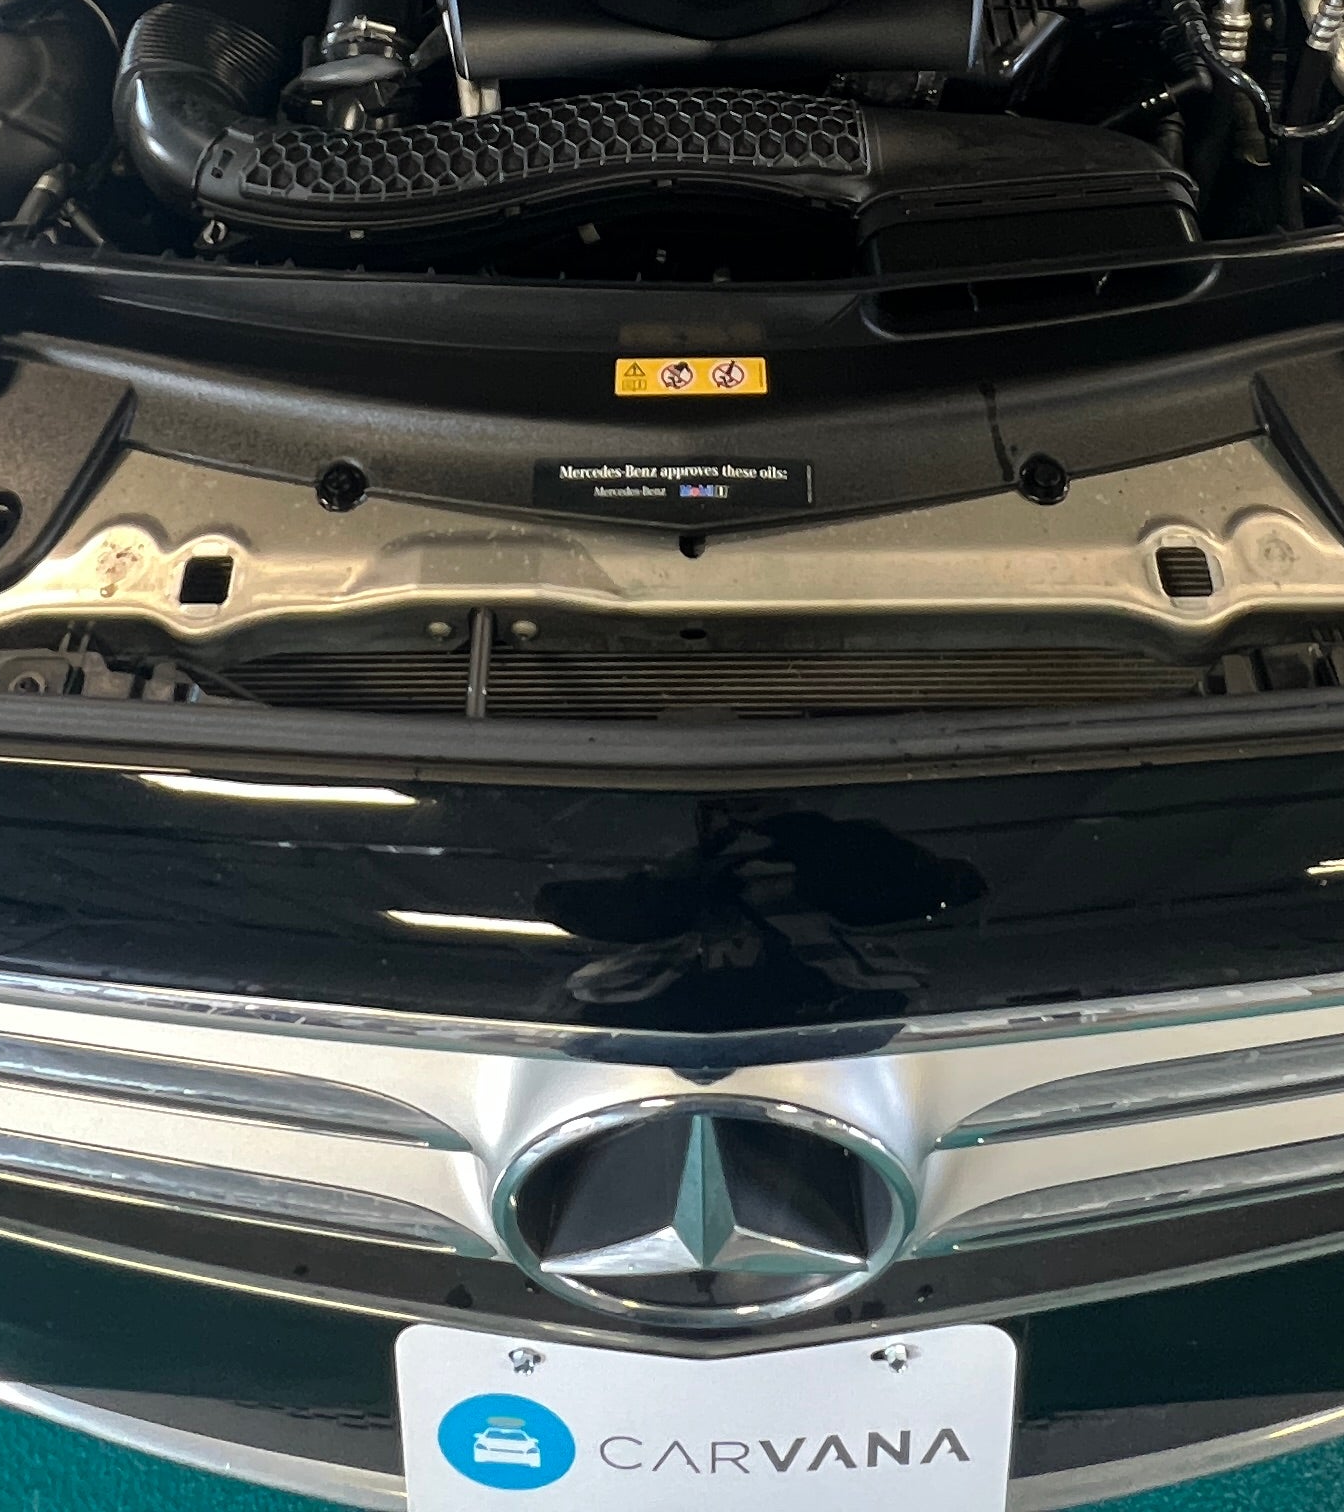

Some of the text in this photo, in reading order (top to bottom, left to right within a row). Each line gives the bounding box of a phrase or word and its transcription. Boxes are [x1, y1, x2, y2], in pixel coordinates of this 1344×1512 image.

[559, 463, 788, 479] Mercedes-Benz approves these oils:
[593, 485, 667, 497] Mercedes-Benz
[599, 1427, 970, 1474] CARVANA
